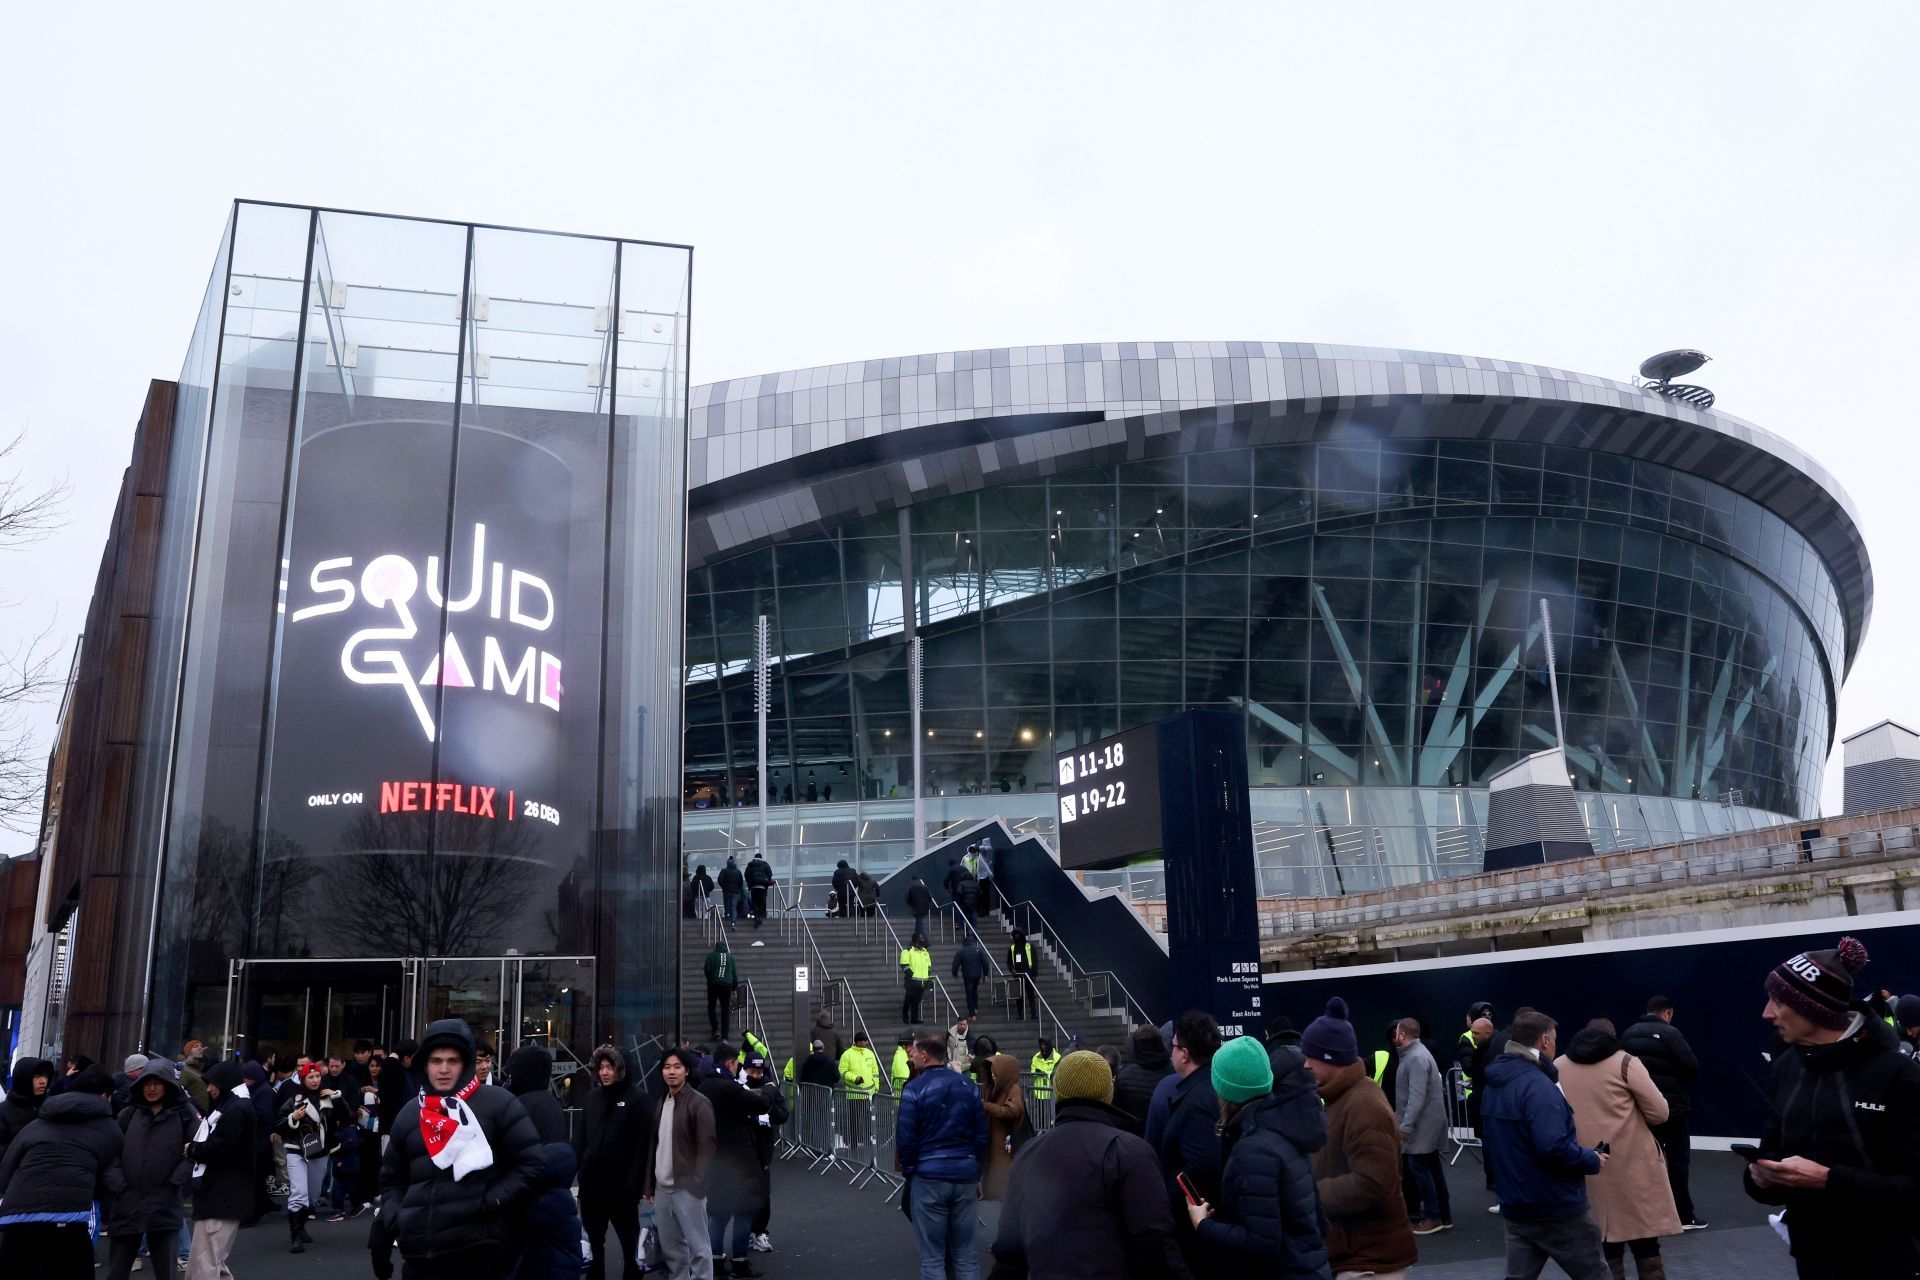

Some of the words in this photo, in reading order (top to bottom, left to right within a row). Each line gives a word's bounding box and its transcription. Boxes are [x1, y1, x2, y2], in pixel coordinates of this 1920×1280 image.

[293, 523, 554, 631] SQUID
[1080, 742, 1124, 777] 11-18
[308, 793, 341, 807] ONLY
[341, 792, 363, 805] ON
[380, 781, 496, 819] NETFLIX
[523, 800, 540, 818] 26
[1081, 781, 1126, 815] 19-22
[1241, 975, 1259, 984] Square
